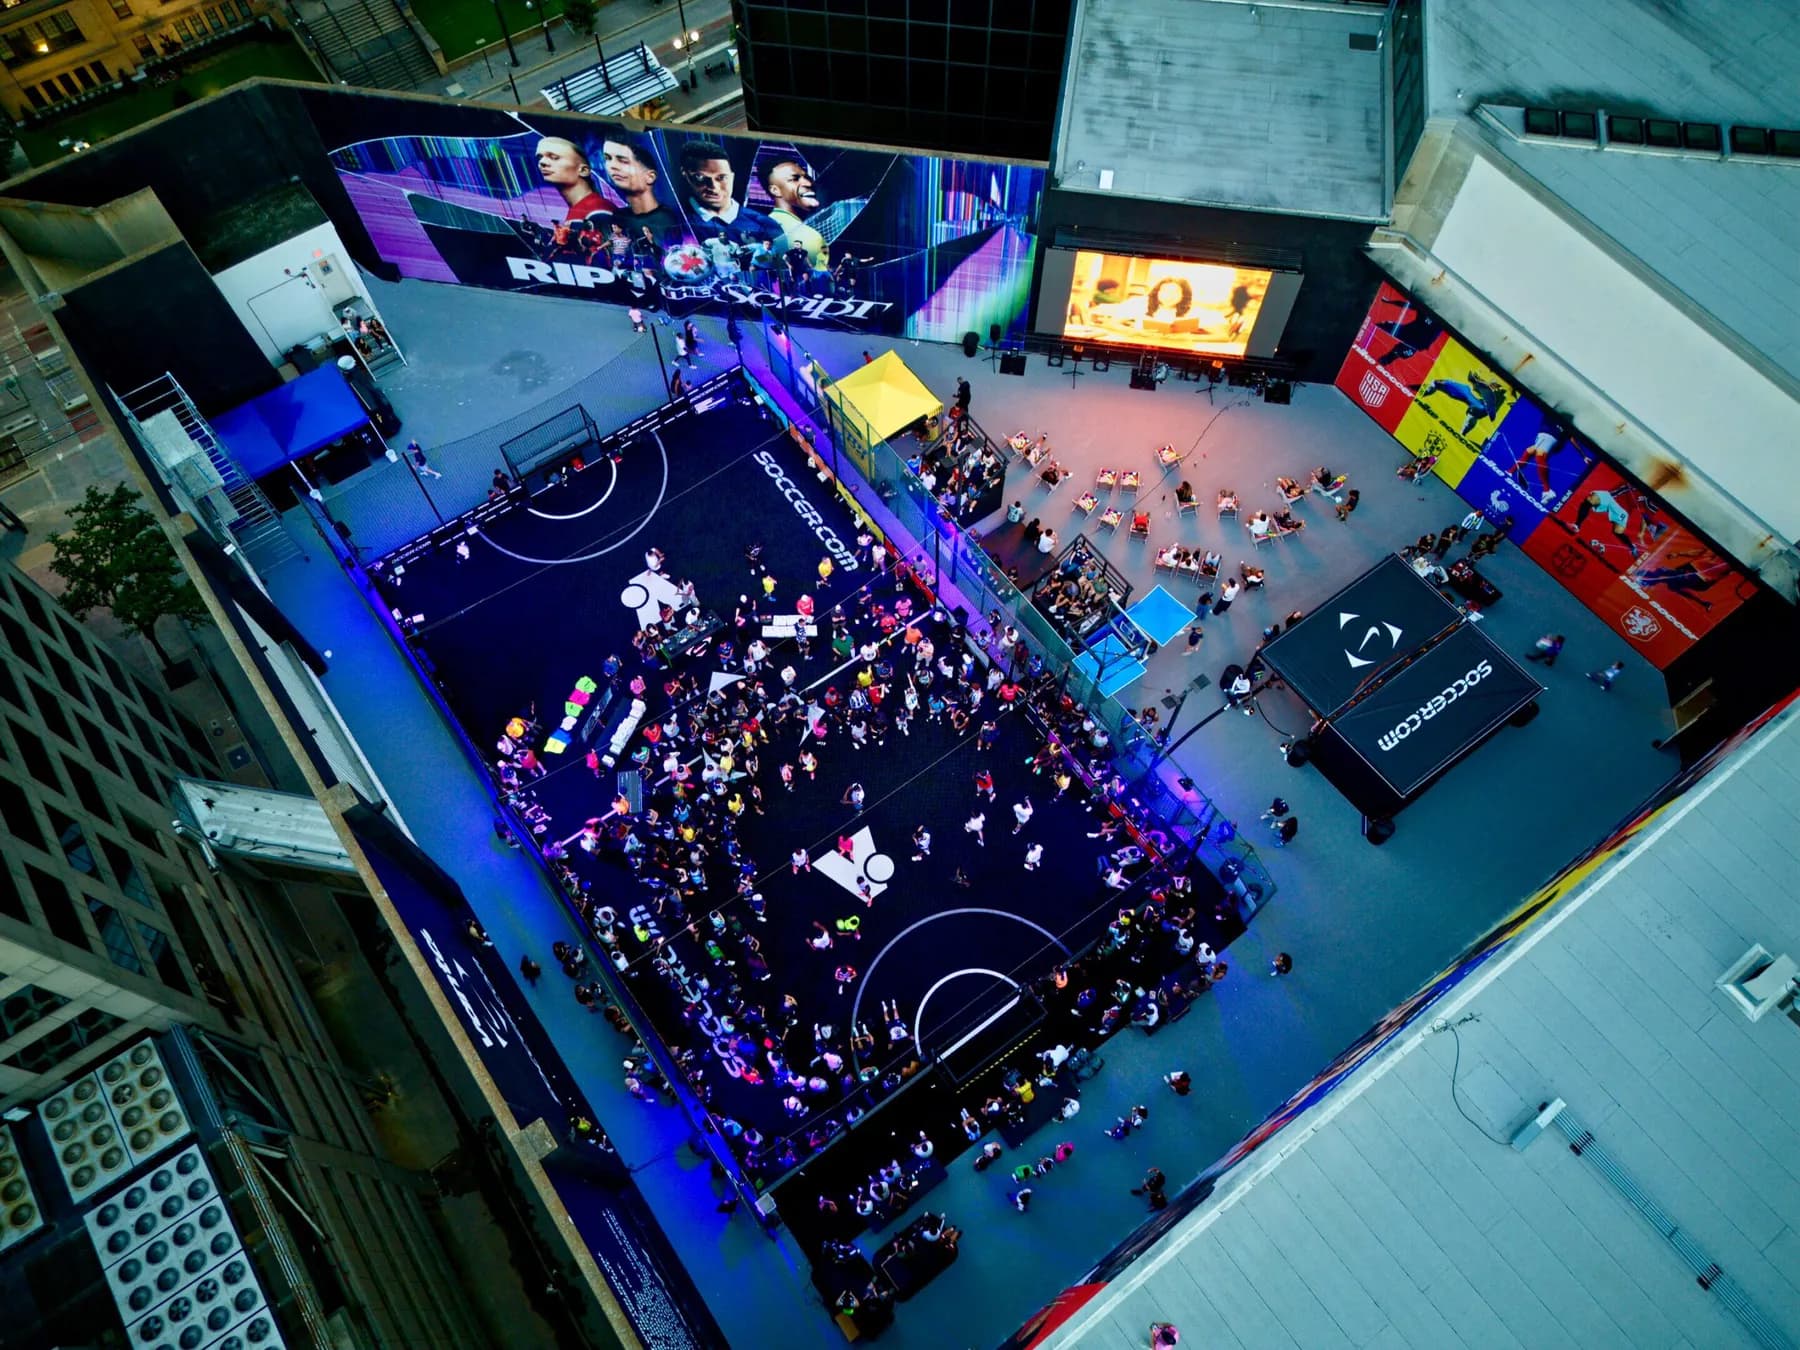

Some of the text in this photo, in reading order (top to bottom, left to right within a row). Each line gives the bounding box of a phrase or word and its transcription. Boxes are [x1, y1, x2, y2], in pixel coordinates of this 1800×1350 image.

[505, 256, 616, 289] RIP
[1366, 372, 1386, 395] USA
[753, 450, 859, 572] SOCCER.COM
[1377, 659, 1493, 752] SOCCER.COM
